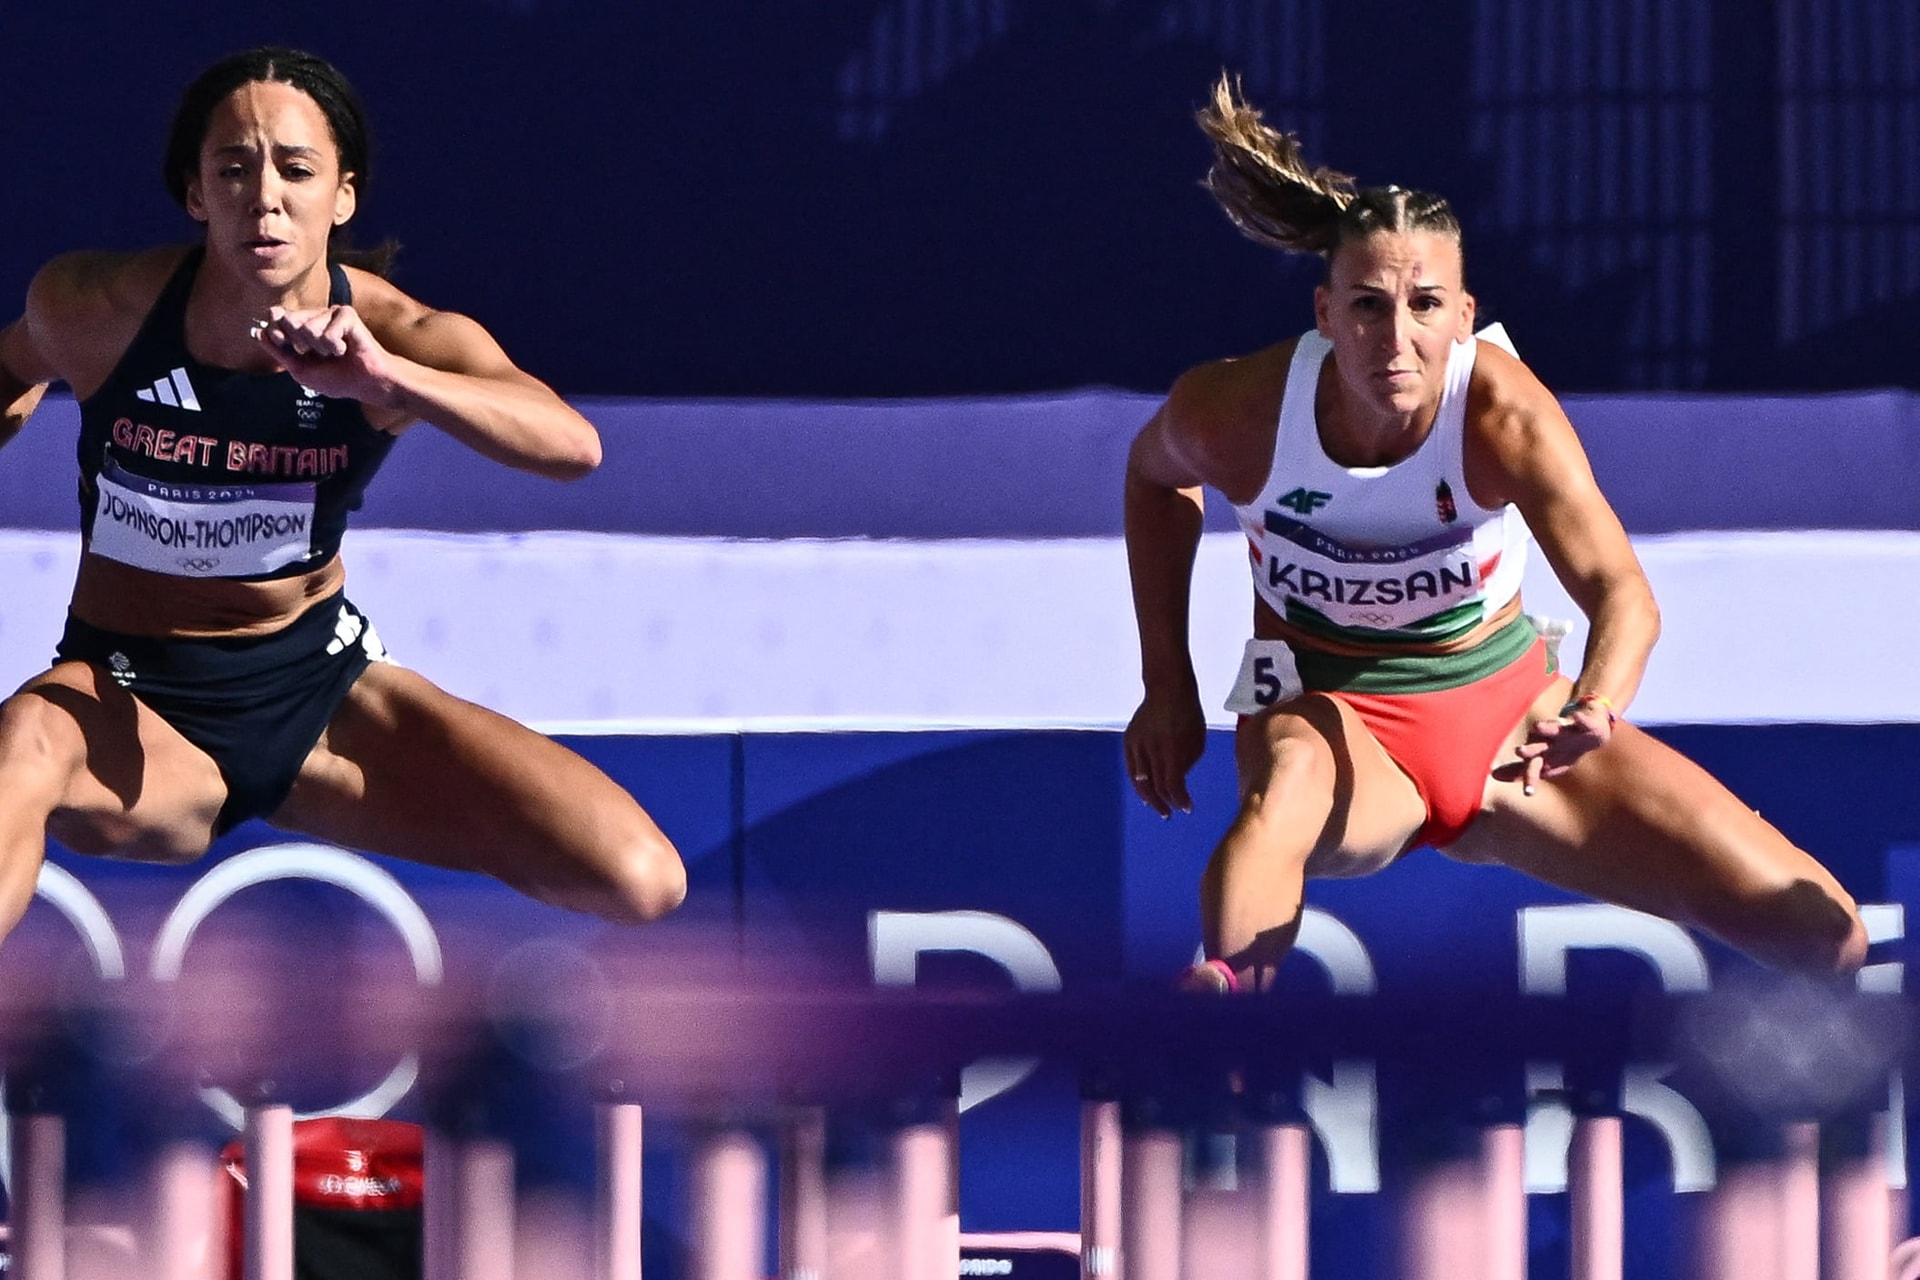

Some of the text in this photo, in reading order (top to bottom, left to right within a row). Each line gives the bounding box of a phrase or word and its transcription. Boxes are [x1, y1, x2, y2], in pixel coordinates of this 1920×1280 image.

[112, 417, 349, 476] GREAT BRITAIN
[147, 483, 201, 500] PARIS
[103, 491, 306, 549] JOHNSON-THOMPSON
[1268, 556, 1473, 605] KRIZSAN
[1253, 656, 1282, 706] 5
